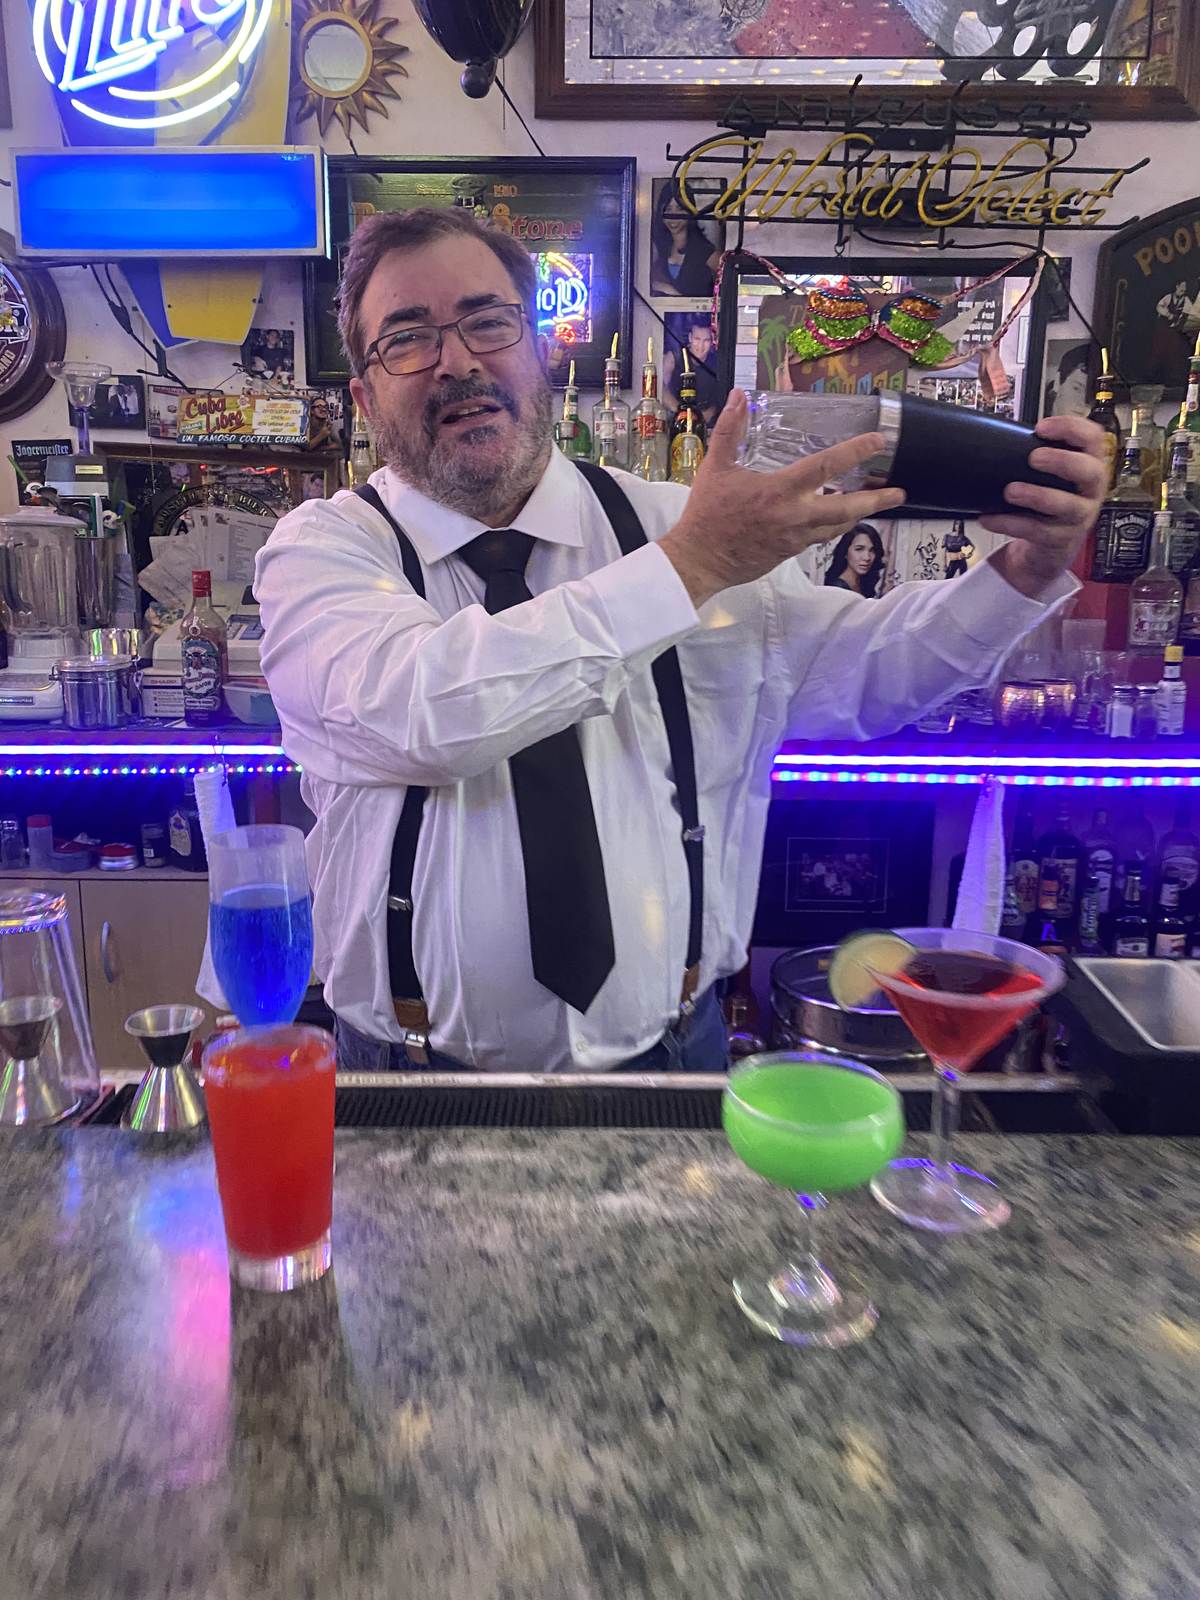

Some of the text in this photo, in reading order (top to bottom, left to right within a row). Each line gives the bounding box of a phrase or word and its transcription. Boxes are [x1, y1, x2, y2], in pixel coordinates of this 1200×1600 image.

[680, 133, 1126, 227] World Select
[185, 394, 226, 419] Cuba
[205, 409, 244, 434] Libre
[182, 434, 308, 444] UN FAMOSO COCTEL CUBANO
